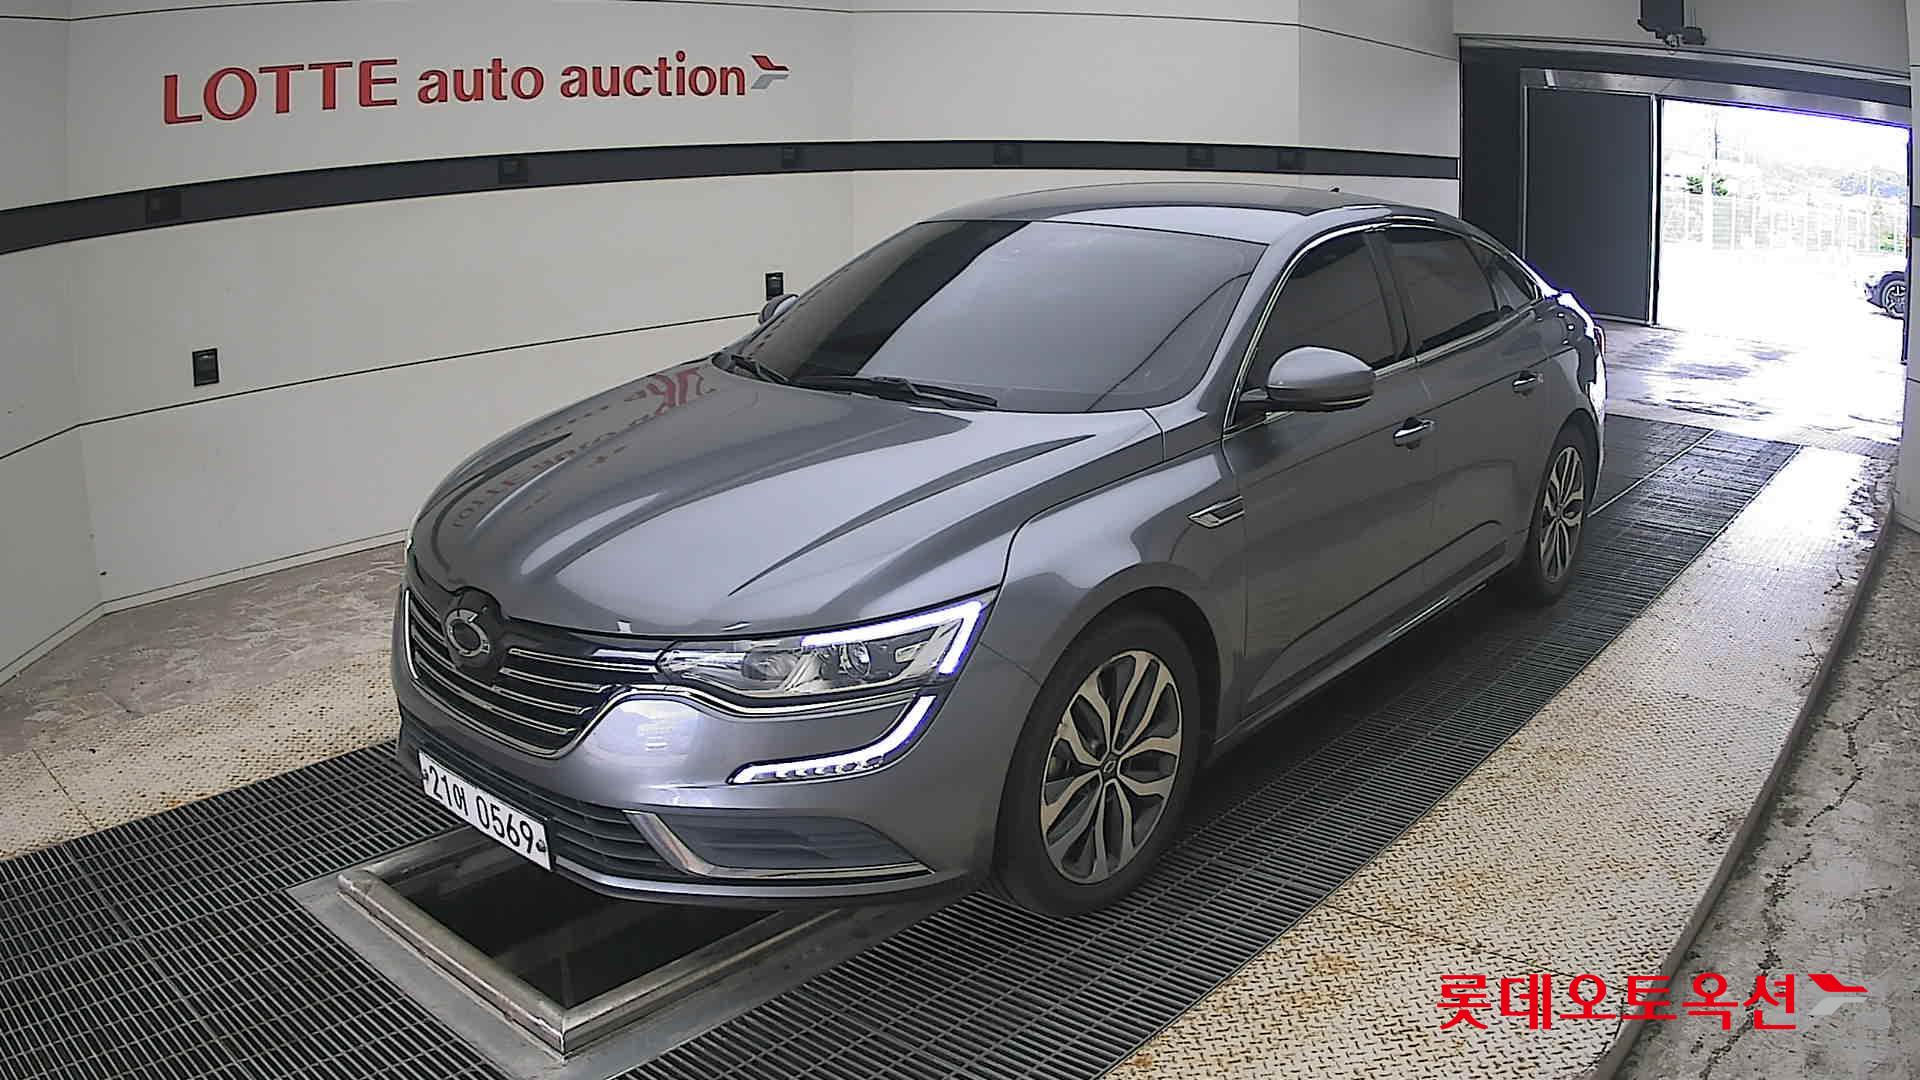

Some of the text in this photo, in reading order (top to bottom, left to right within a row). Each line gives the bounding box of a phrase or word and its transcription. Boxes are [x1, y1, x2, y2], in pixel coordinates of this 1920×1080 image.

[163, 50, 746, 124] LOTTE auto auction
[428, 764, 535, 855] 21어 0569
